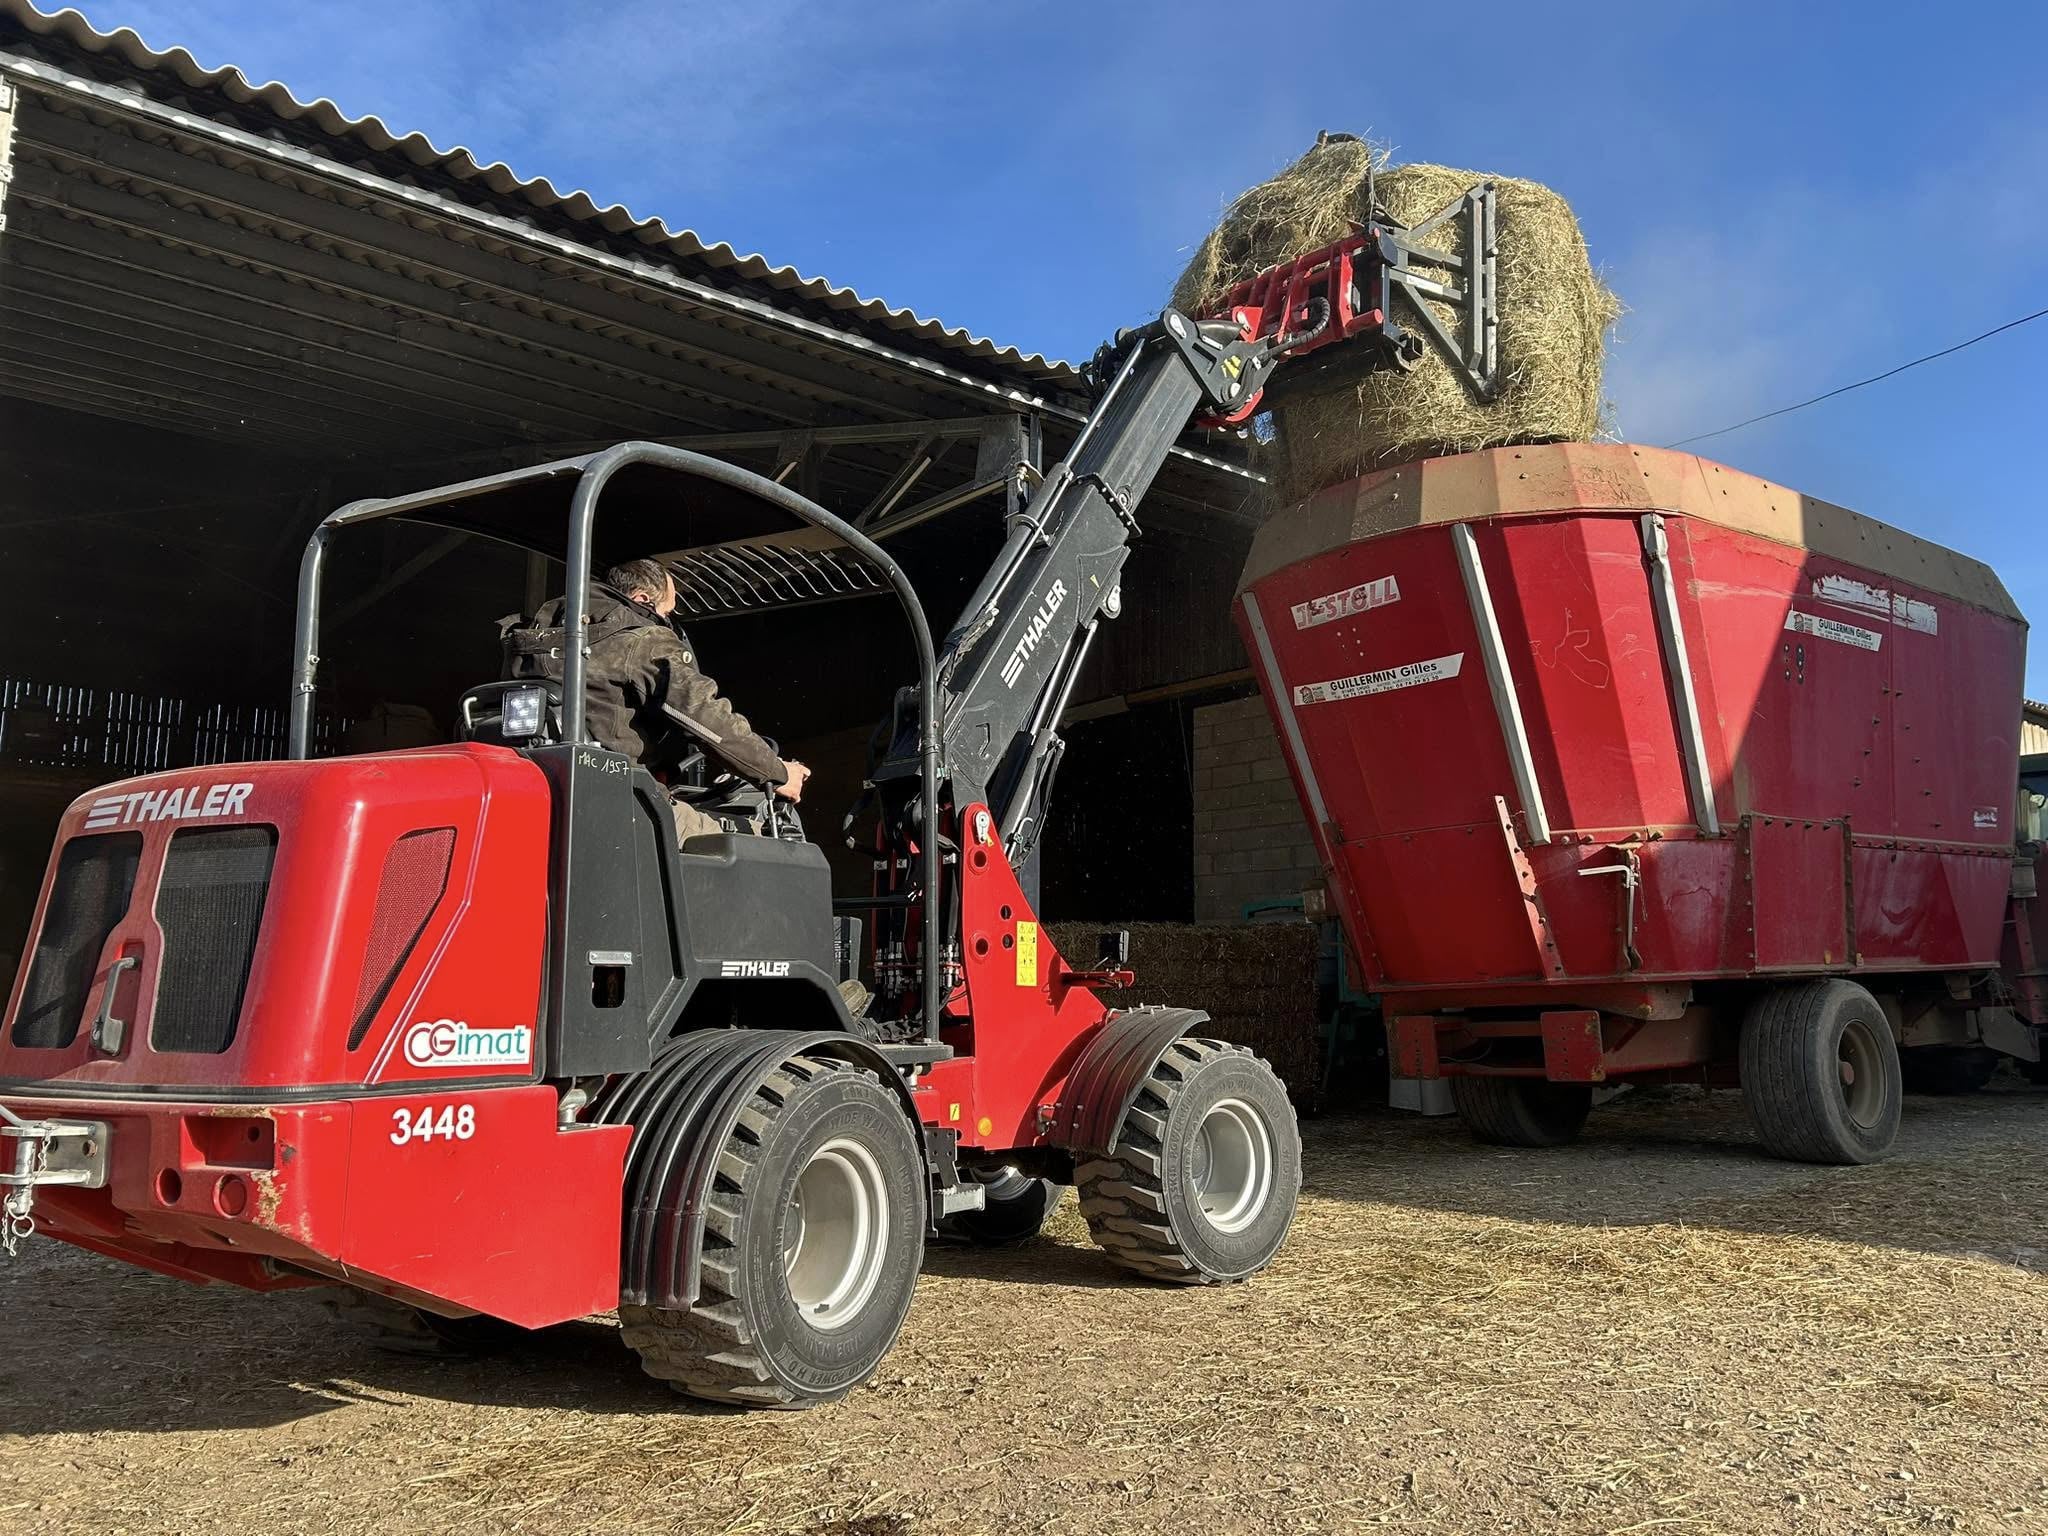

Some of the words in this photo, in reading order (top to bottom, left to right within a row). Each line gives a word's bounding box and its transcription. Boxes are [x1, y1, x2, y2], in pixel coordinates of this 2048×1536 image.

[1819, 618, 1855, 637] GUILLERMIN
[1856, 628, 1873, 642] Gilles
[1330, 669, 1397, 691] GUILLERMIN
[1400, 662, 1438, 677] Gilles
[578, 751, 598, 768] MAC
[600, 758, 630, 776] 1957
[122, 783, 254, 824] THALER
[408, 1023, 526, 1063] CGimat
[390, 1103, 476, 1146] 3448
